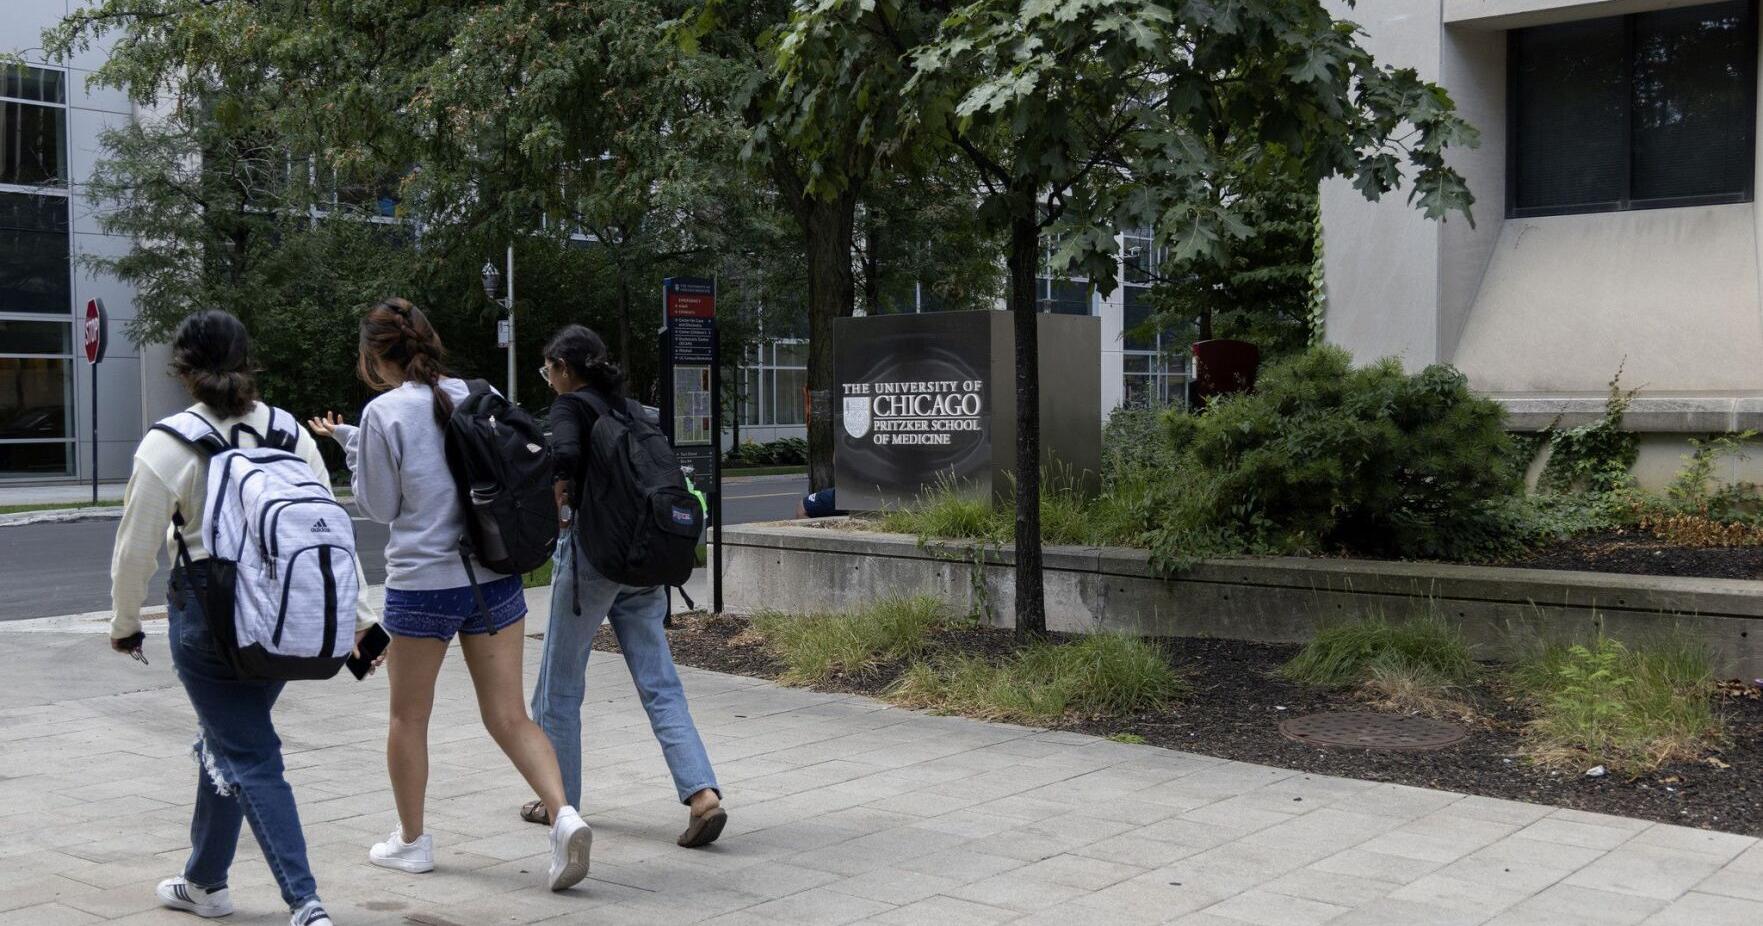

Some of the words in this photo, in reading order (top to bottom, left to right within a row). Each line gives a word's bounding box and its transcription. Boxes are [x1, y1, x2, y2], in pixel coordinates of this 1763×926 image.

[85, 317, 98, 346] STOP
[842, 383, 870, 394] THE
[875, 381, 958, 394] UNIVERSITY
[963, 380, 983, 392] OF
[873, 393, 982, 417] CHICAGO
[873, 420, 930, 431] PRITZKER
[931, 419, 981, 431] SCHOOL
[873, 434, 890, 445] OF
[891, 433, 951, 445] MEDICINE
